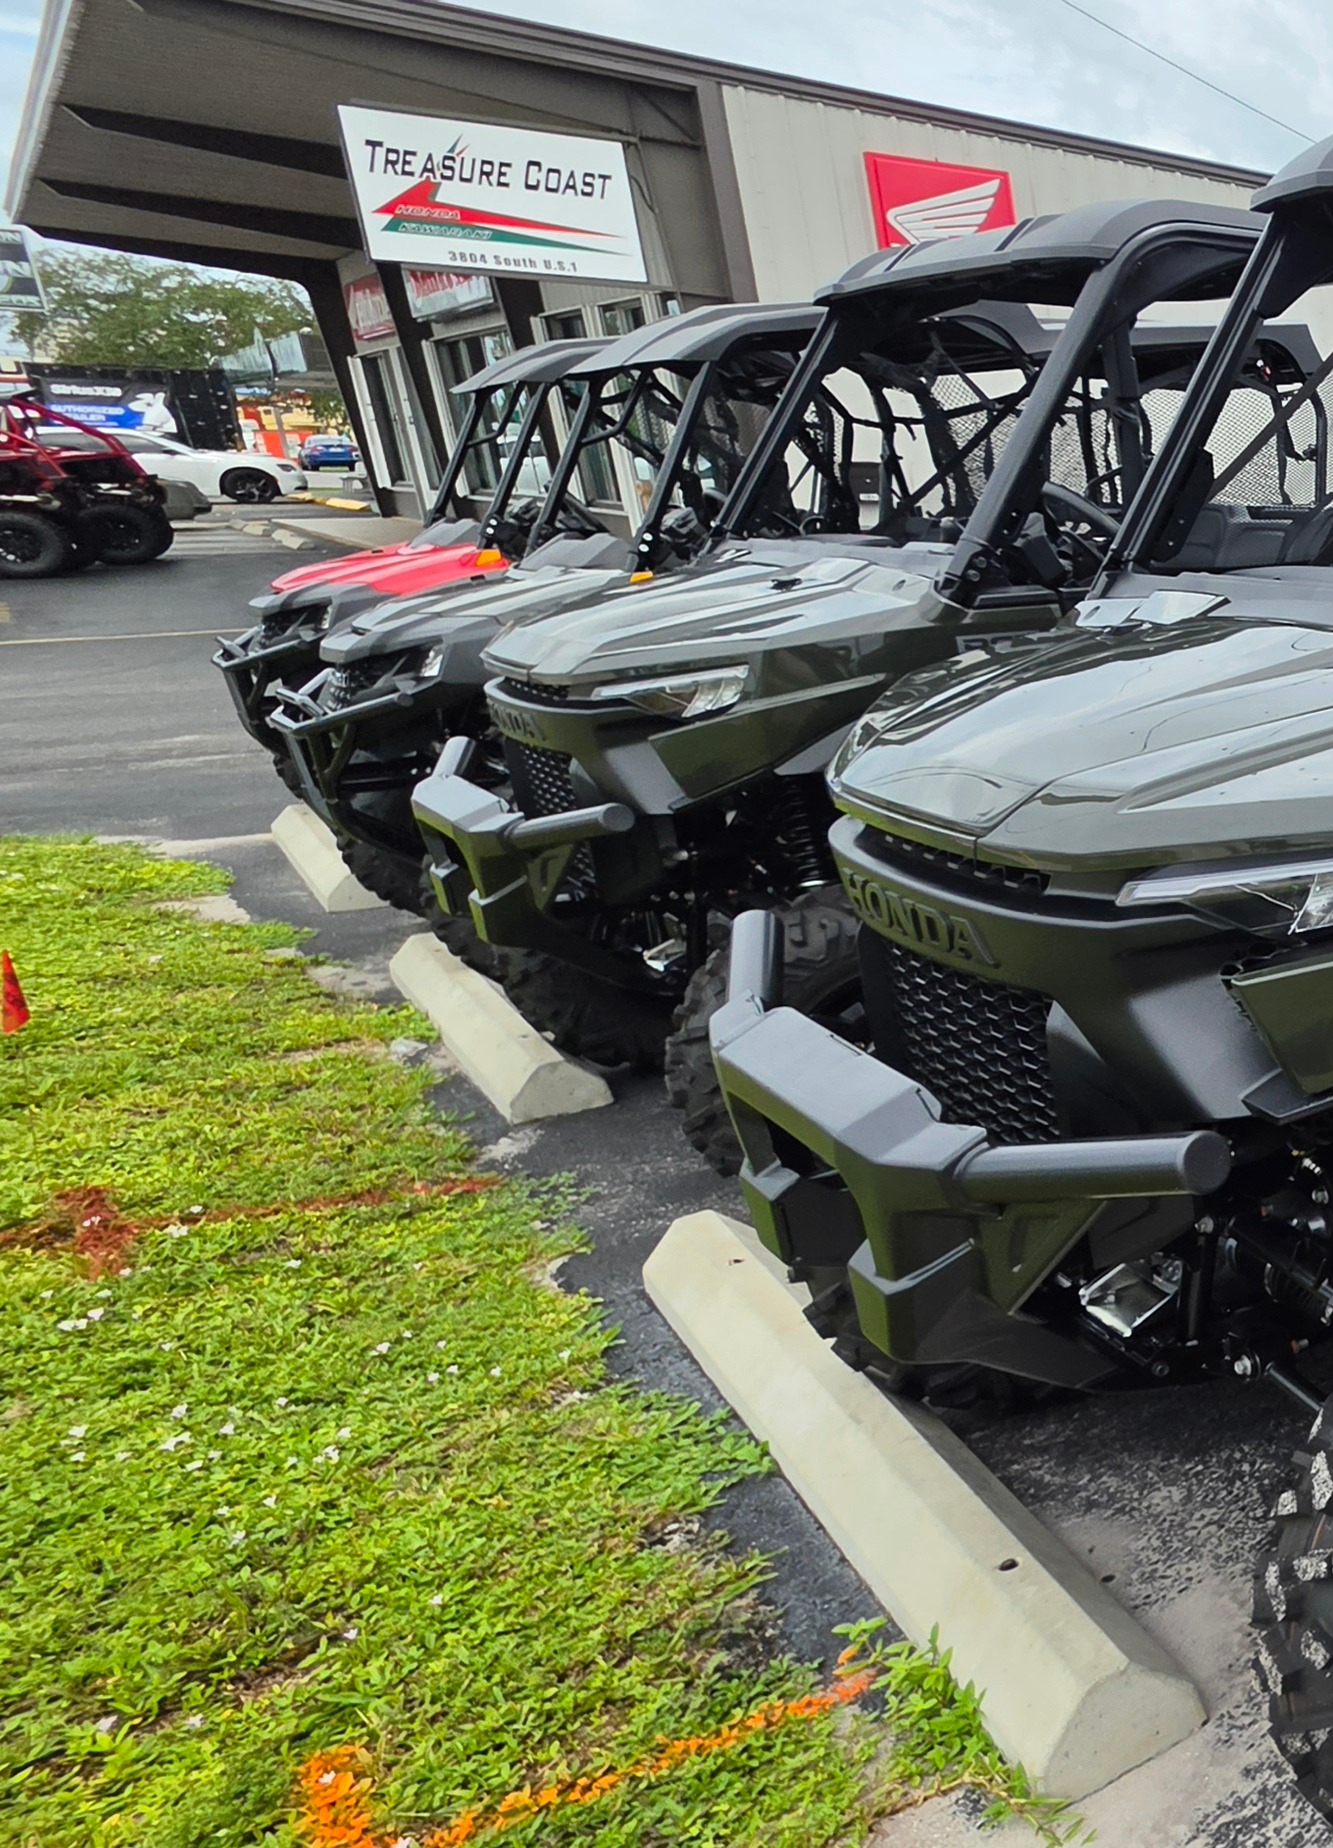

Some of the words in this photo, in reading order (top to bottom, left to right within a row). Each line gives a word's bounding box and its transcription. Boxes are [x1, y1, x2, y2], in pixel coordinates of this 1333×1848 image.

[365, 139, 512, 188] TREASURE
[523, 160, 612, 199] COAST
[395, 204, 461, 220] HONDA
[448, 250, 488, 266] 3804
[493, 254, 537, 270] South
[842, 867, 1001, 970] HONDA
